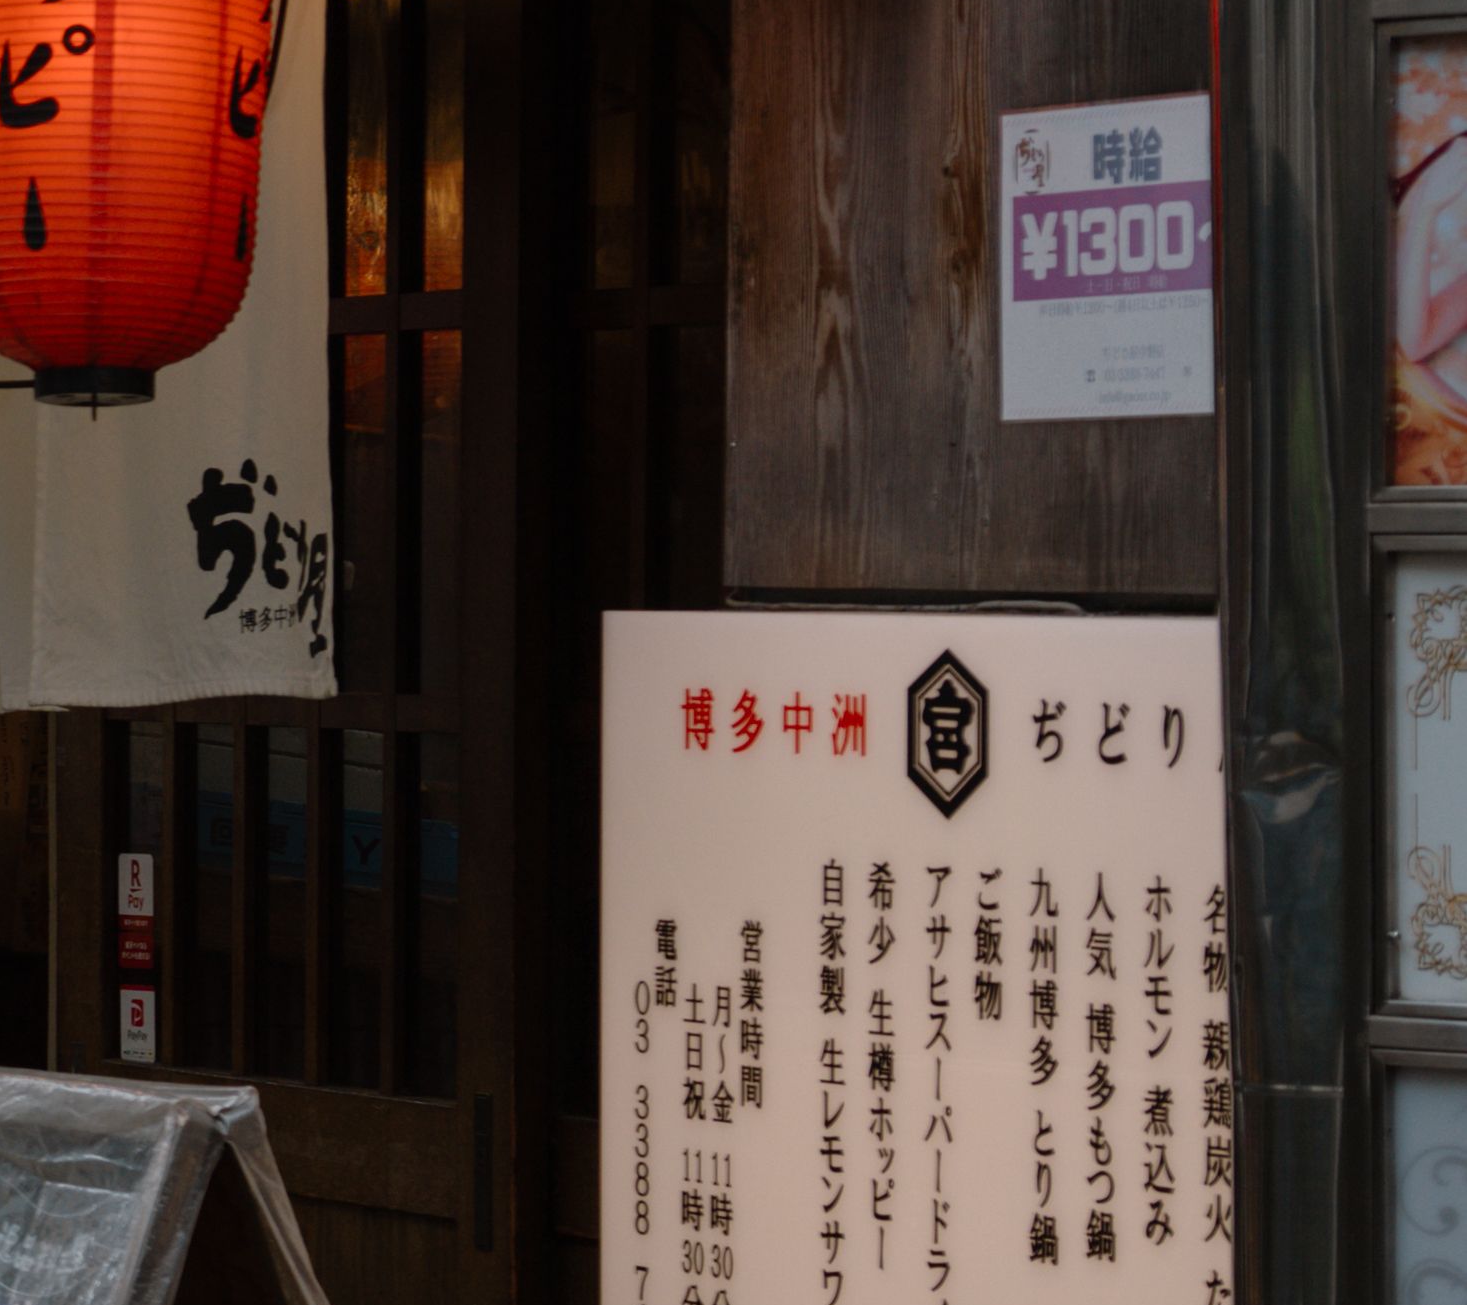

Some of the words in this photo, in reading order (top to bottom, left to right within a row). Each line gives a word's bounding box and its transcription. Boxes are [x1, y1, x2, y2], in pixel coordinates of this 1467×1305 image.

[1090, 125, 1164, 185] 時給
[681, 688, 868, 757] 博多中洲
[1032, 699, 1226, 771] ぢどり
[128, 894, 144, 911] Pay
[654, 919, 678, 1009] 電話
[819, 858, 847, 1016] 自家製
[867, 861, 897, 964] 希少
[974, 868, 1003, 1022] ご飯物
[1029, 867, 1060, 1087] 九州博多
[1086, 872, 1117, 981] 人気
[1143, 874, 1173, 1060] ホルモン
[634, 981, 651, 1054] 03
[682, 983, 707, 1122] 土日祝
[739, 919, 765, 1110] 営業時間
[634, 1085, 651, 1237] 3388
[868, 989, 897, 1271] 生樽ホッピー
[1029, 1108, 1060, 1267] とり鍋
[1085, 1004, 1117, 1264] 博多もつ鍋
[1143, 1084, 1174, 1247] 煮込み
